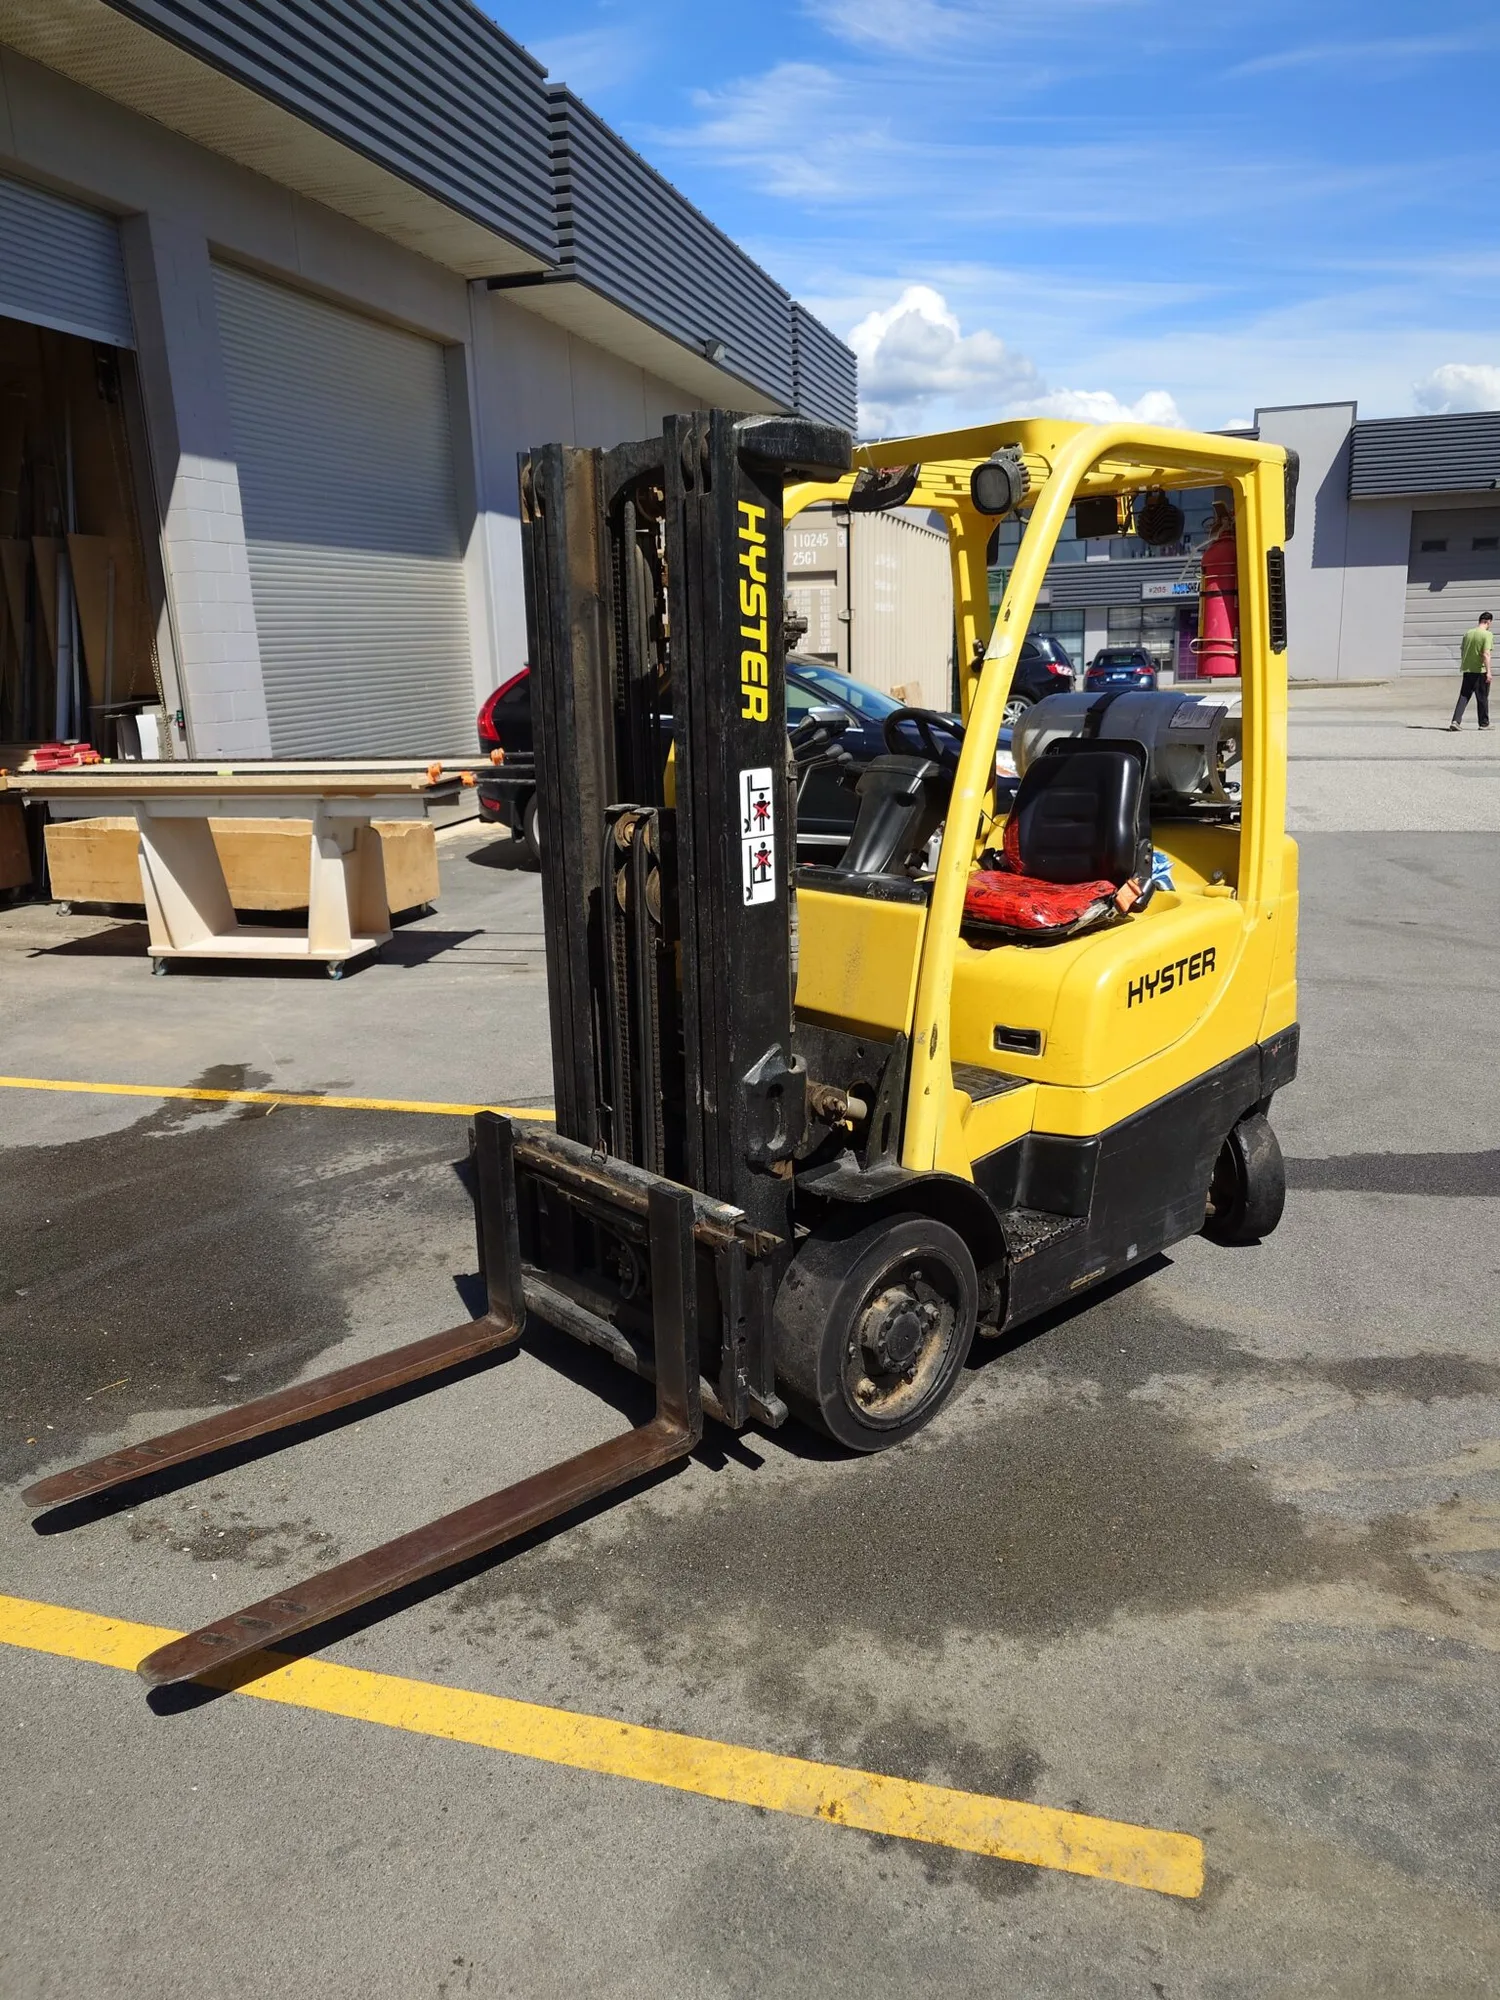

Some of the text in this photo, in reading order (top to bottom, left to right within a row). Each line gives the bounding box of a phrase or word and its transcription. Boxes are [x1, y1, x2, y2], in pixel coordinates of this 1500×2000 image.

[792, 551, 817, 566] 25G1
[793, 532, 829, 548] 110245
[737, 500, 769, 723] HYSTER
[1127, 946, 1216, 1009] HYSTER
